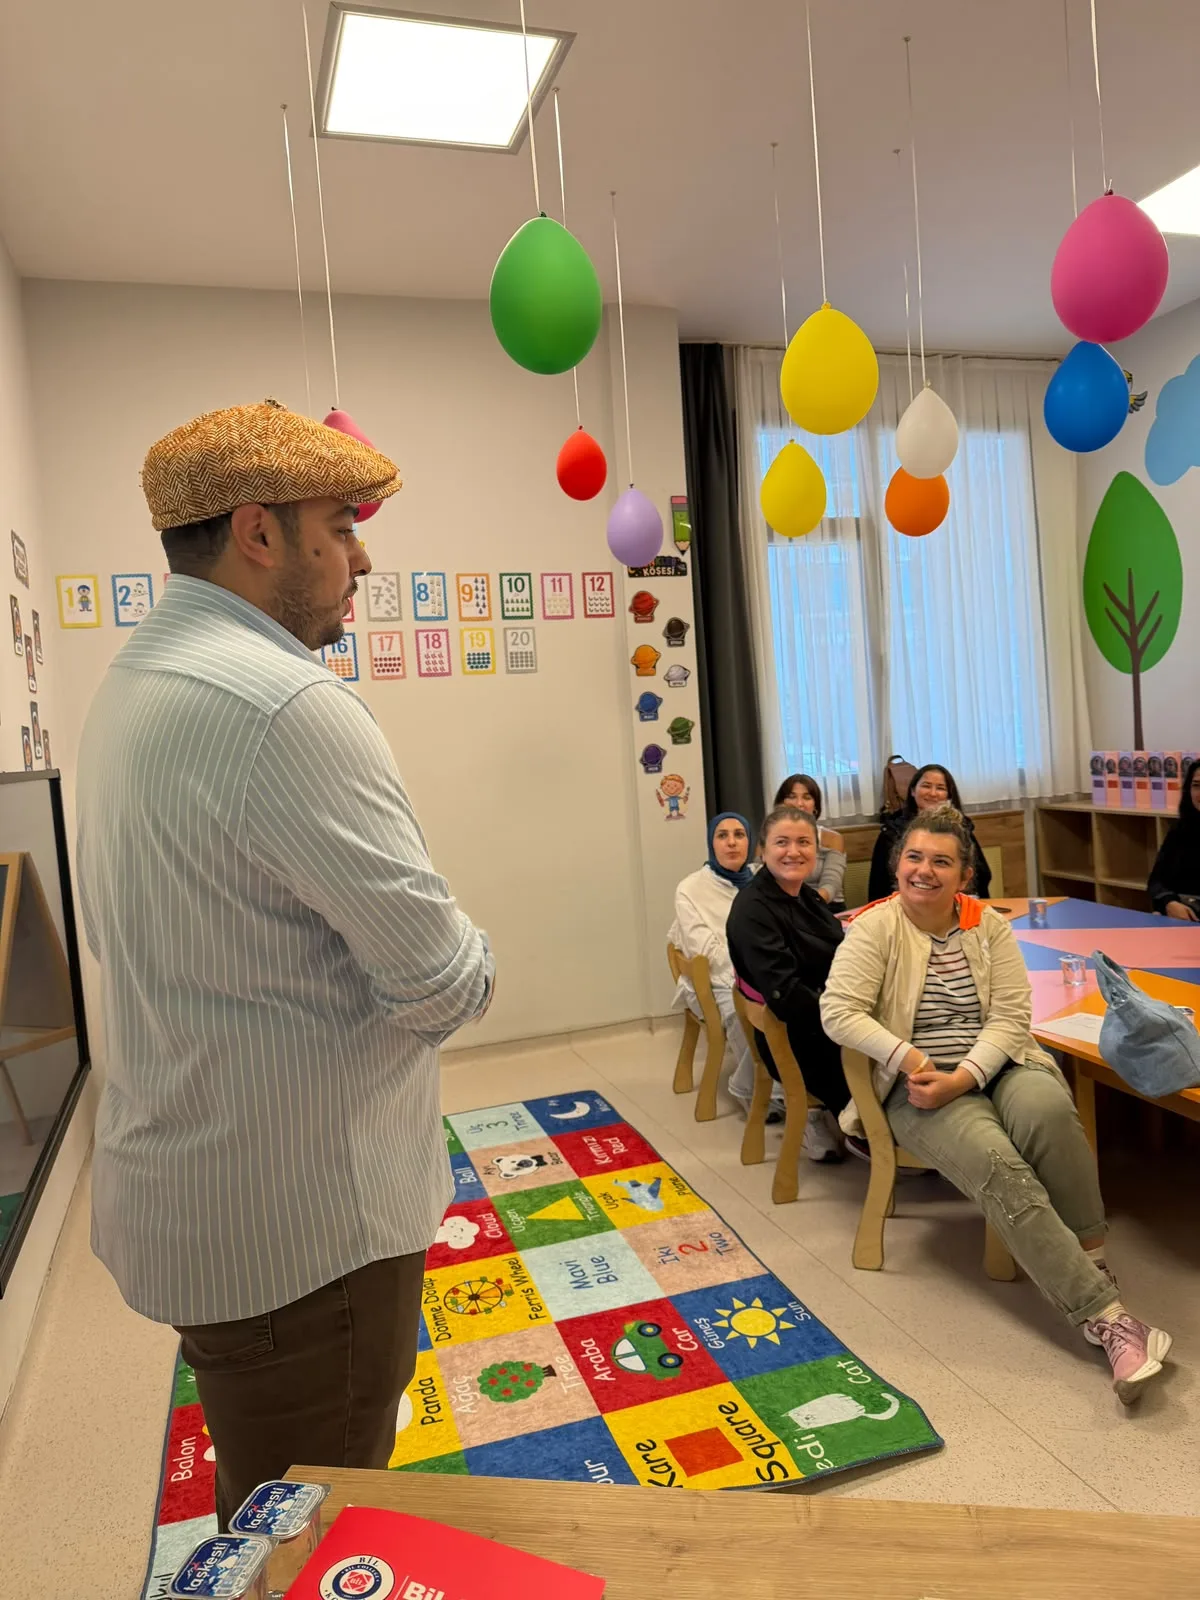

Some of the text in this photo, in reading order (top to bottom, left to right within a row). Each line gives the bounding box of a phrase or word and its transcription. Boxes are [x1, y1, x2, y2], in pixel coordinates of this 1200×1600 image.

[416, 583, 429, 602] 8
[461, 584, 473, 602] 9
[507, 577, 525, 593] 10
[550, 577, 563, 592] 11
[589, 576, 605, 592] 12
[64, 587, 74, 608] 1
[118, 585, 132, 606] 2
[371, 586, 384, 605] 7
[331, 638, 348, 654] 16
[378, 635, 394, 651] 17
[424, 633, 442, 649] 18
[469, 631, 486, 648] 19
[510, 631, 530, 646] 20
[486, 1120, 508, 1129] 3
[602, 1137, 629, 1155] Red
[454, 1166, 477, 1184] Ball
[476, 1212, 503, 1238] Cloud
[677, 1240, 709, 1256] 2
[709, 1231, 734, 1257] Two
[653, 1245, 680, 1265] İki
[559, 1258, 594, 1290] Mavi
[590, 1254, 619, 1285] Blue
[502, 1256, 547, 1321] Ferris Wheel
[423, 1277, 452, 1343] Dönme Dolap
[788, 1301, 812, 1322] Sun
[672, 1327, 699, 1351] Car
[693, 1317, 725, 1350] Güneş
[580, 1337, 617, 1381] Araba
[556, 1353, 582, 1394] Tree
[836, 1360, 872, 1384] Cat
[413, 1376, 444, 1426] Panda
[717, 1400, 789, 1482] Square
[794, 1433, 836, 1470] edi
[171, 1435, 197, 1483] Balon
[635, 1438, 684, 1488] Kare
[403, 1581, 445, 1600] Bil
